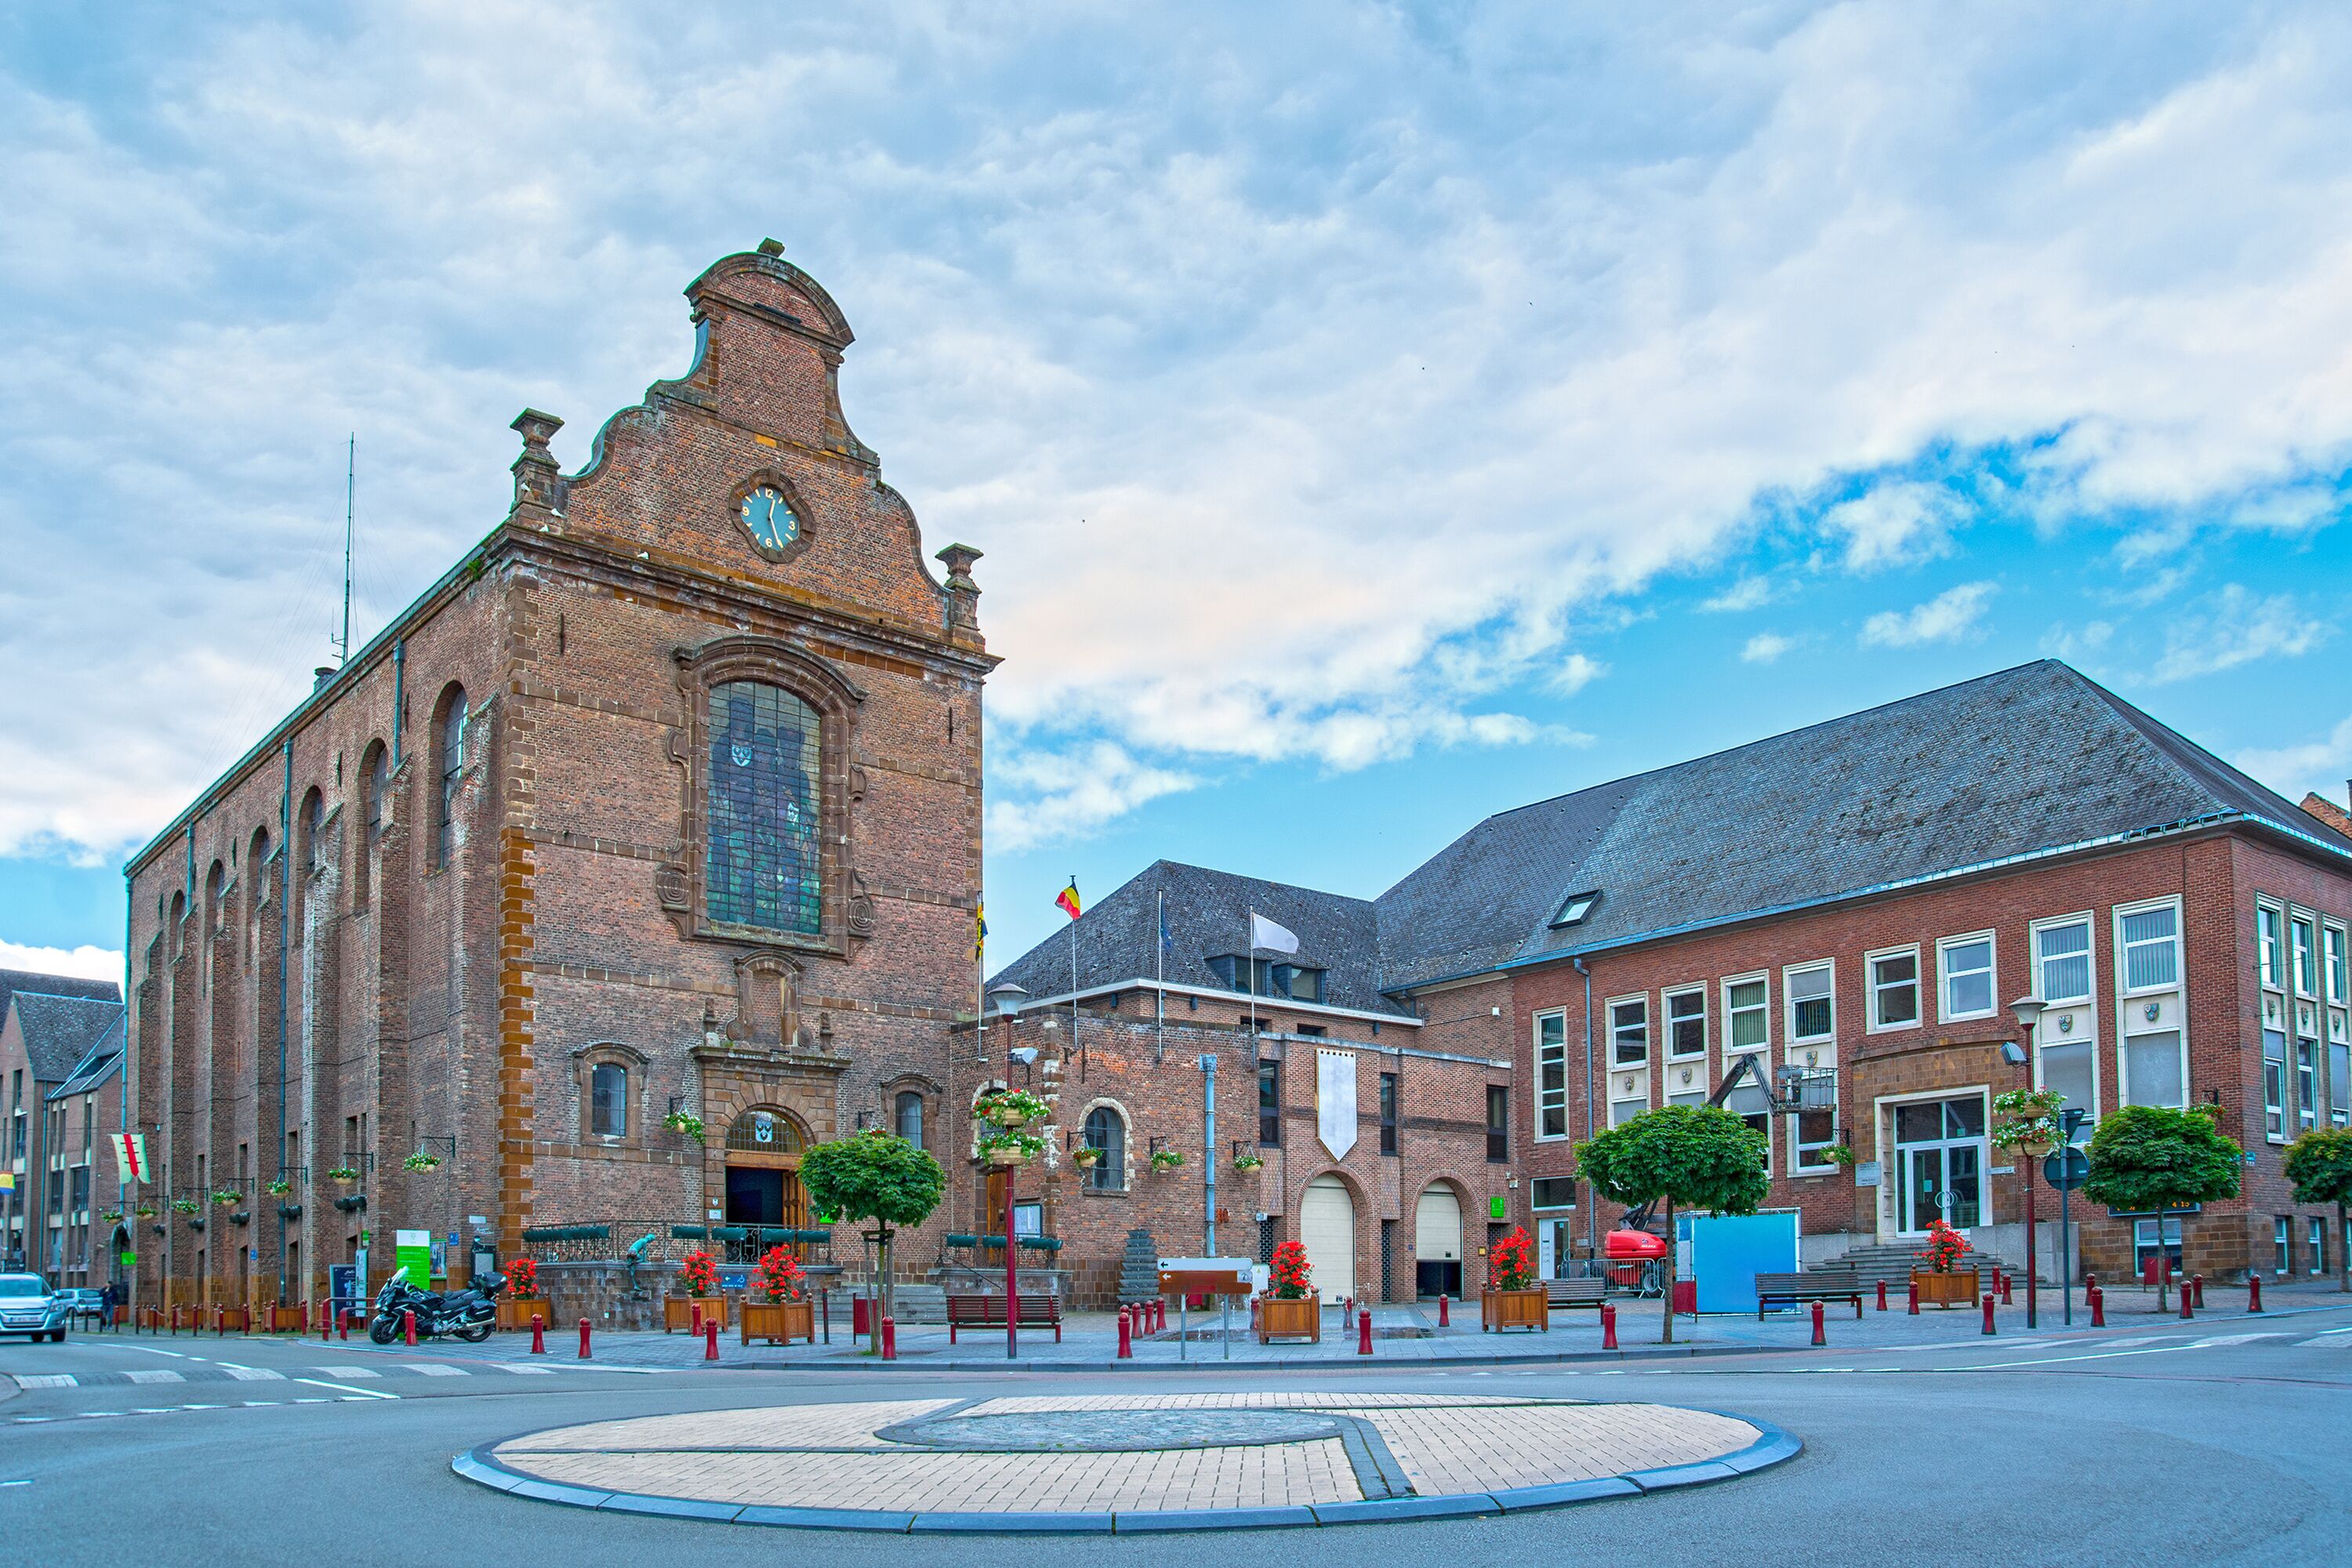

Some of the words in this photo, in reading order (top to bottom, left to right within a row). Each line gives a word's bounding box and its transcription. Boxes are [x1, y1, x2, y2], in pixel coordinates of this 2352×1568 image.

[765, 488, 773, 499] 12
[742, 507, 750, 516] 9
[789, 521, 795, 530] 3
[765, 538, 772, 547] 6
